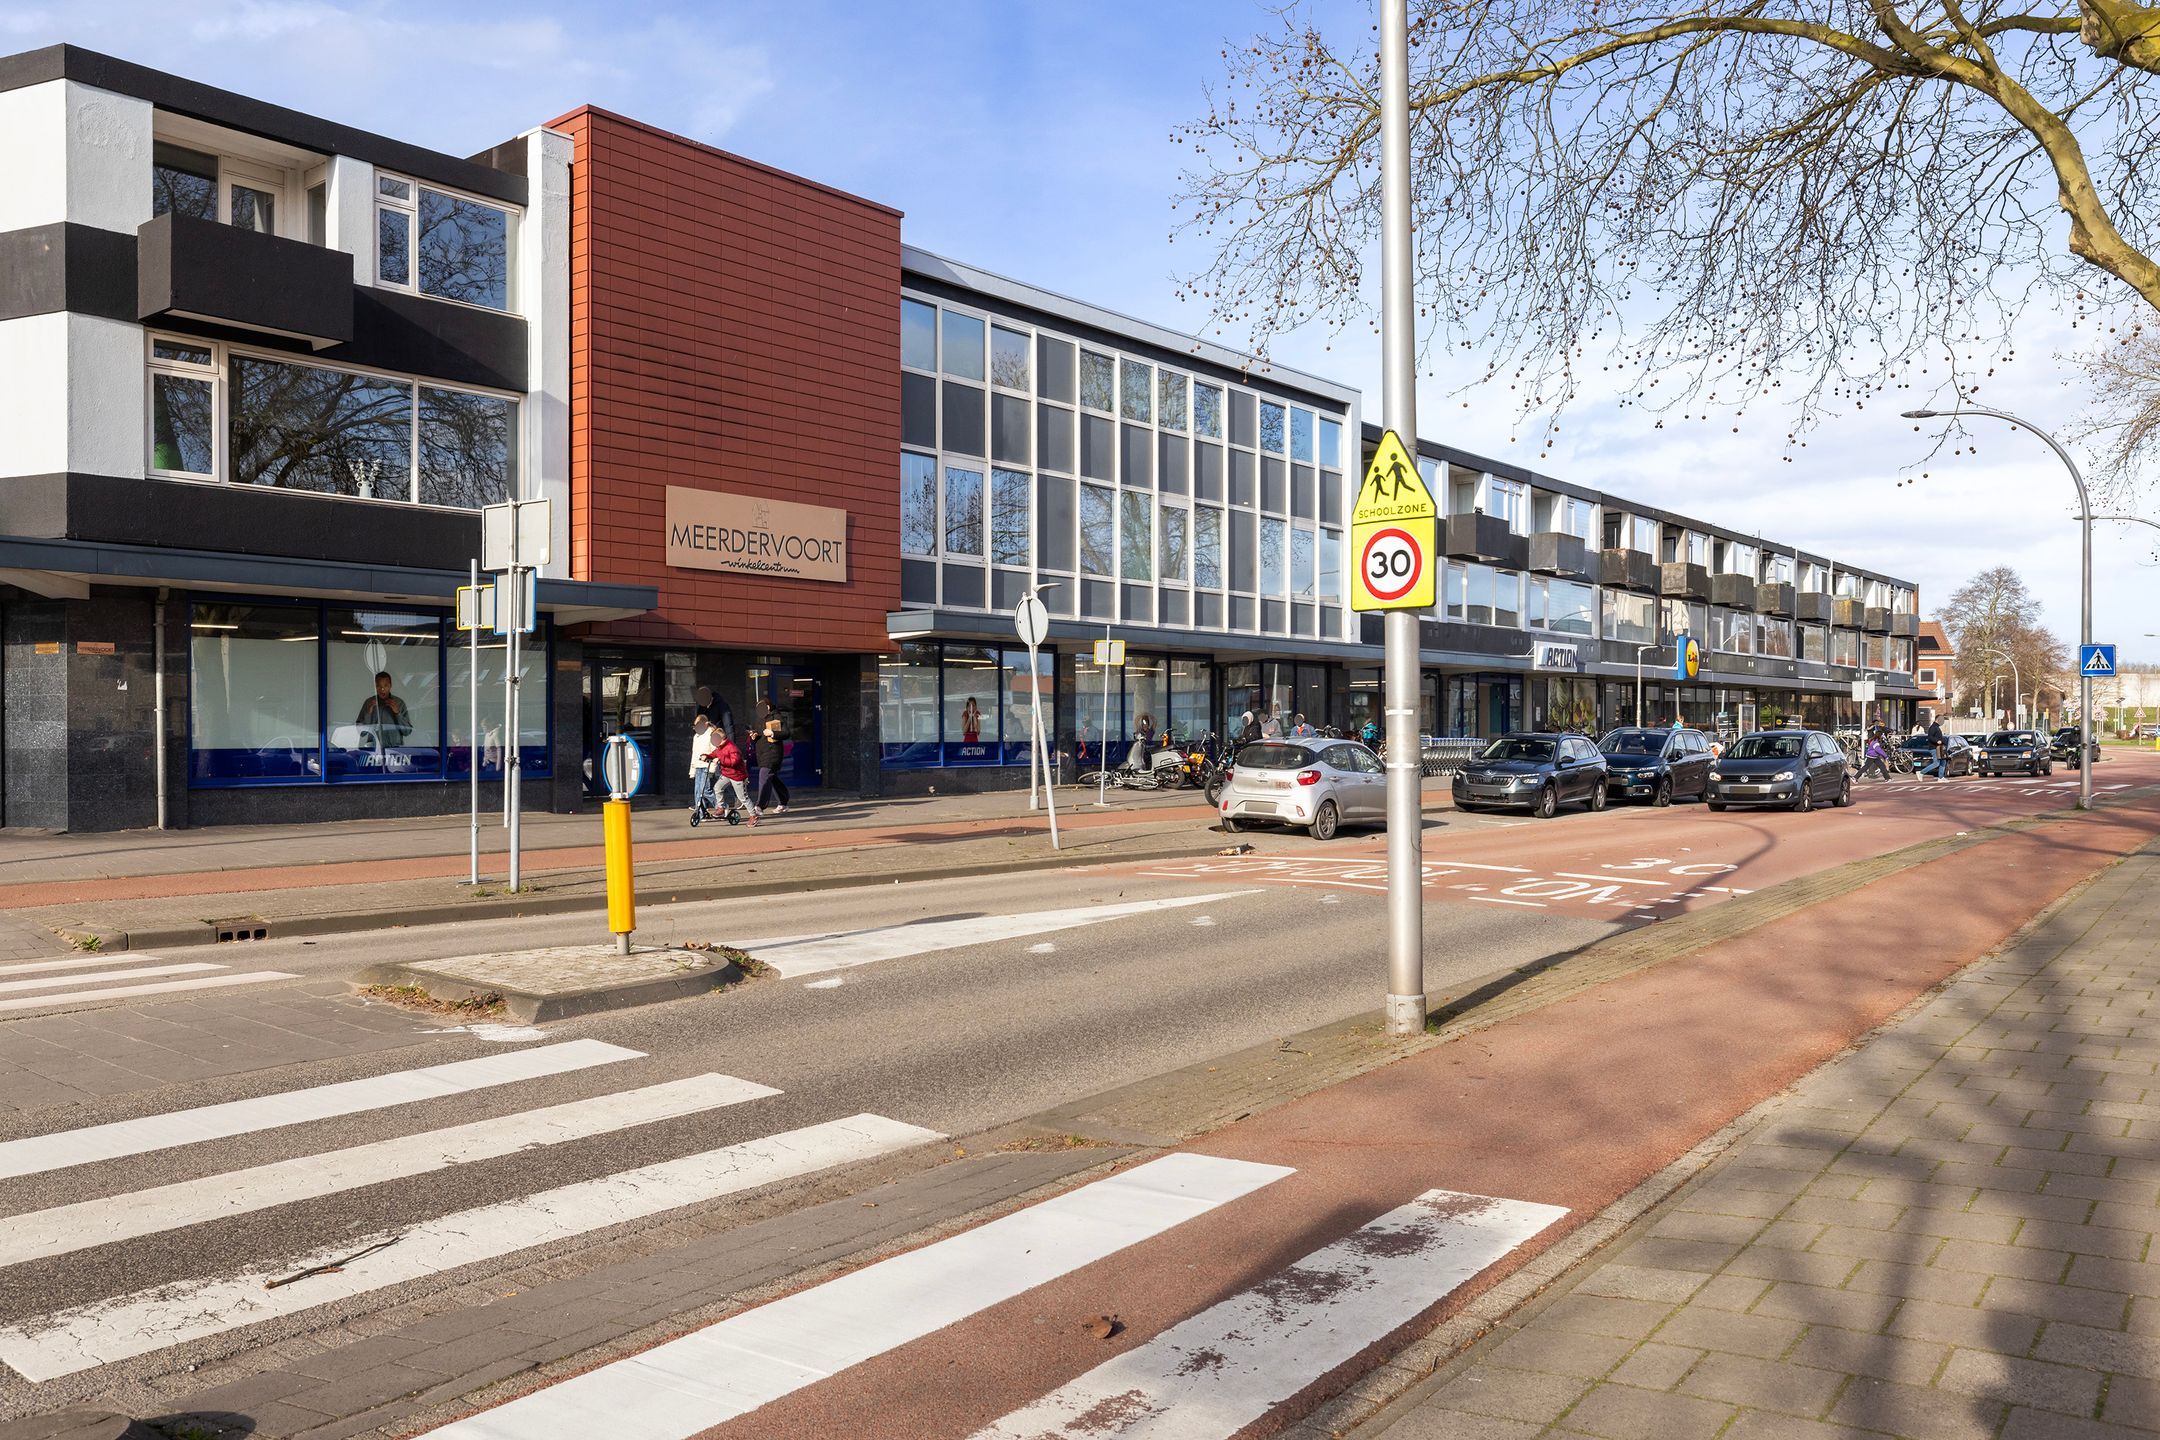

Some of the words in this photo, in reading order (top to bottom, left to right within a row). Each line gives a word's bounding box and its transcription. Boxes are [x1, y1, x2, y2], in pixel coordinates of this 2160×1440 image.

[1359, 503, 1427, 519] SCHOOLZONE
[671, 523, 842, 563] MEERDERVOORT
[721, 557, 800, 574] winkelcentrum
[1371, 549, 1411, 578] 30
[1546, 647, 1578, 668] ACTION
[961, 746, 986, 756] ACTION
[365, 754, 412, 767] ACTION
